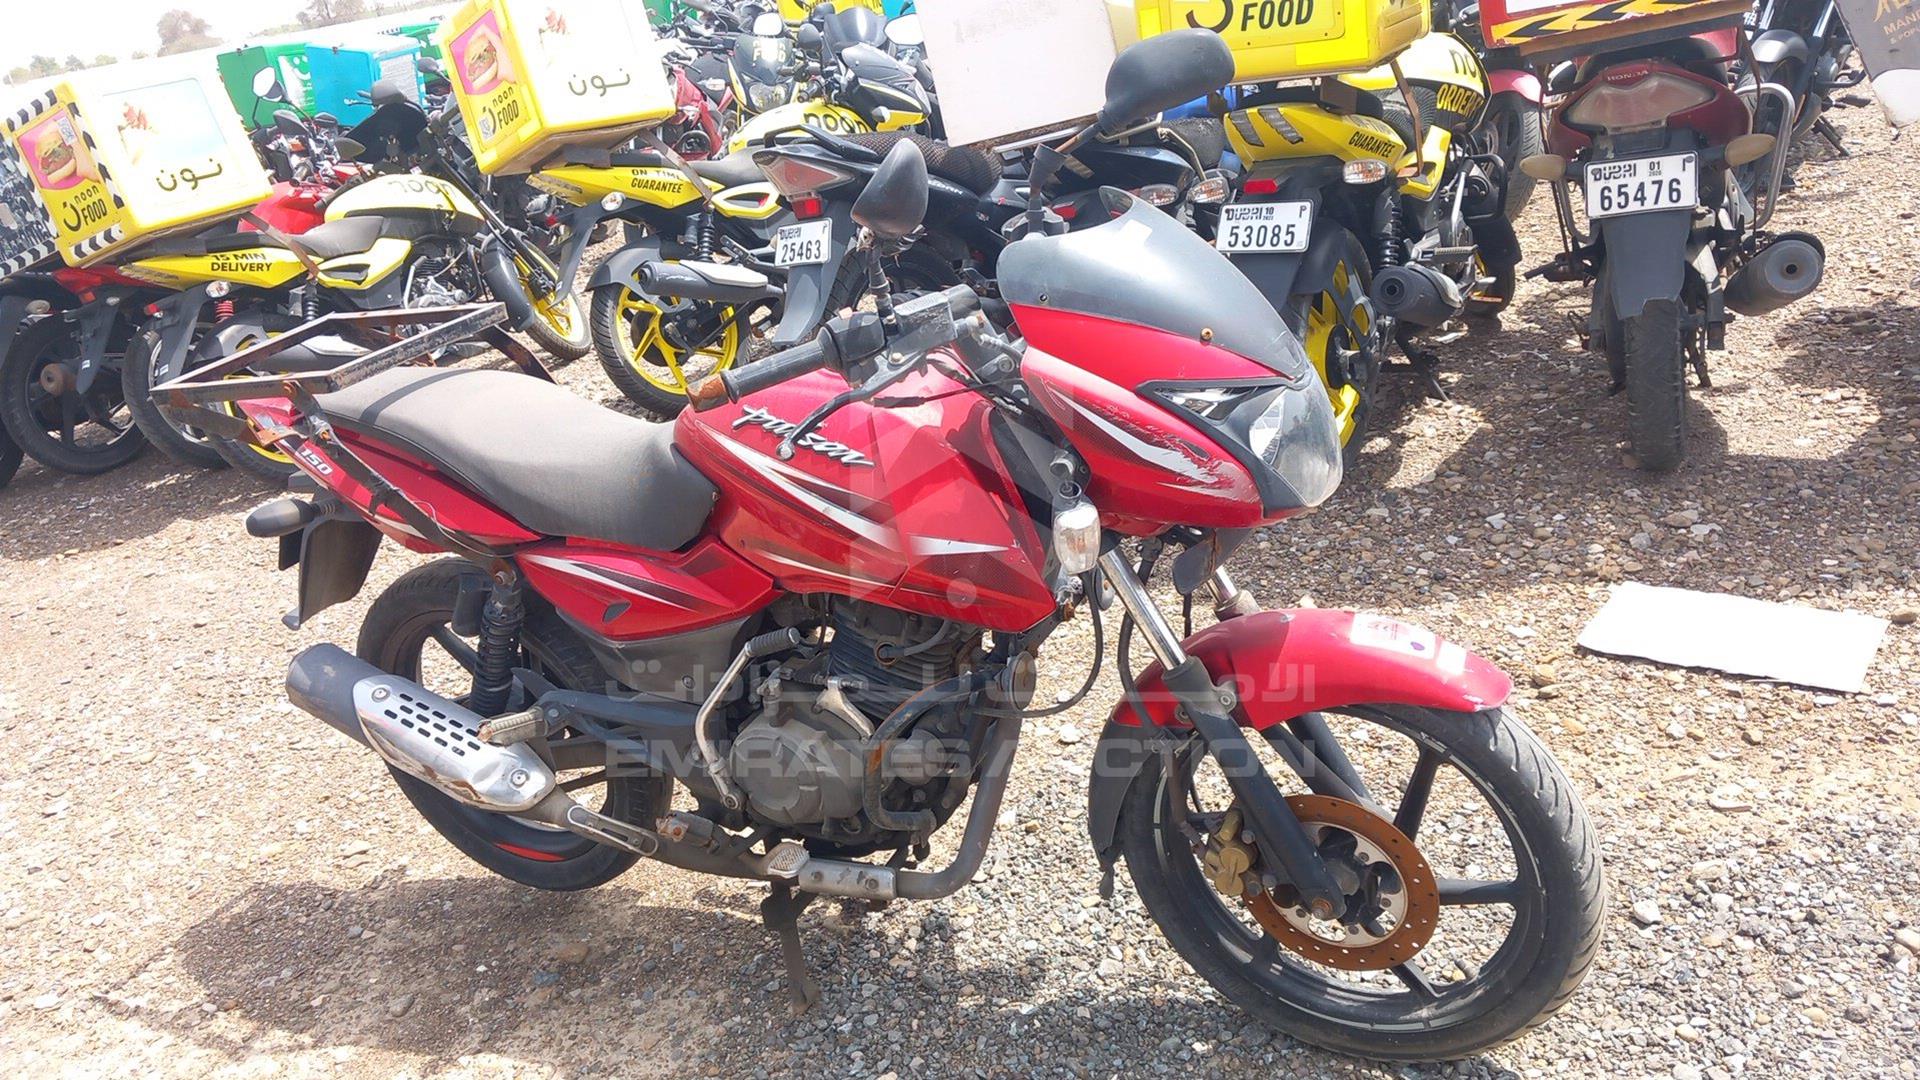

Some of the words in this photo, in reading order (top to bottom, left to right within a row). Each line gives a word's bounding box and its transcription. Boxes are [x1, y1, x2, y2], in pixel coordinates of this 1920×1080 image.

[1241, 0, 1313, 31] FOOD
[568, 68, 631, 96] نون
[493, 87, 514, 106] noon
[498, 100, 520, 129] FOOD
[1348, 131, 1396, 158] GUARANTEE
[156, 158, 223, 192] نون
[1649, 161, 1661, 171] 01
[74, 185, 100, 205] noon
[631, 178, 684, 194] GUARANTEE
[1600, 178, 1681, 211] 65476
[81, 198, 108, 227] FOOD
[1228, 224, 1296, 248] 53085
[781, 239, 821, 263] 25463
[211, 262, 273, 272] DELIVERY
[732, 404, 875, 467] pusar
[301, 448, 333, 475] 150
